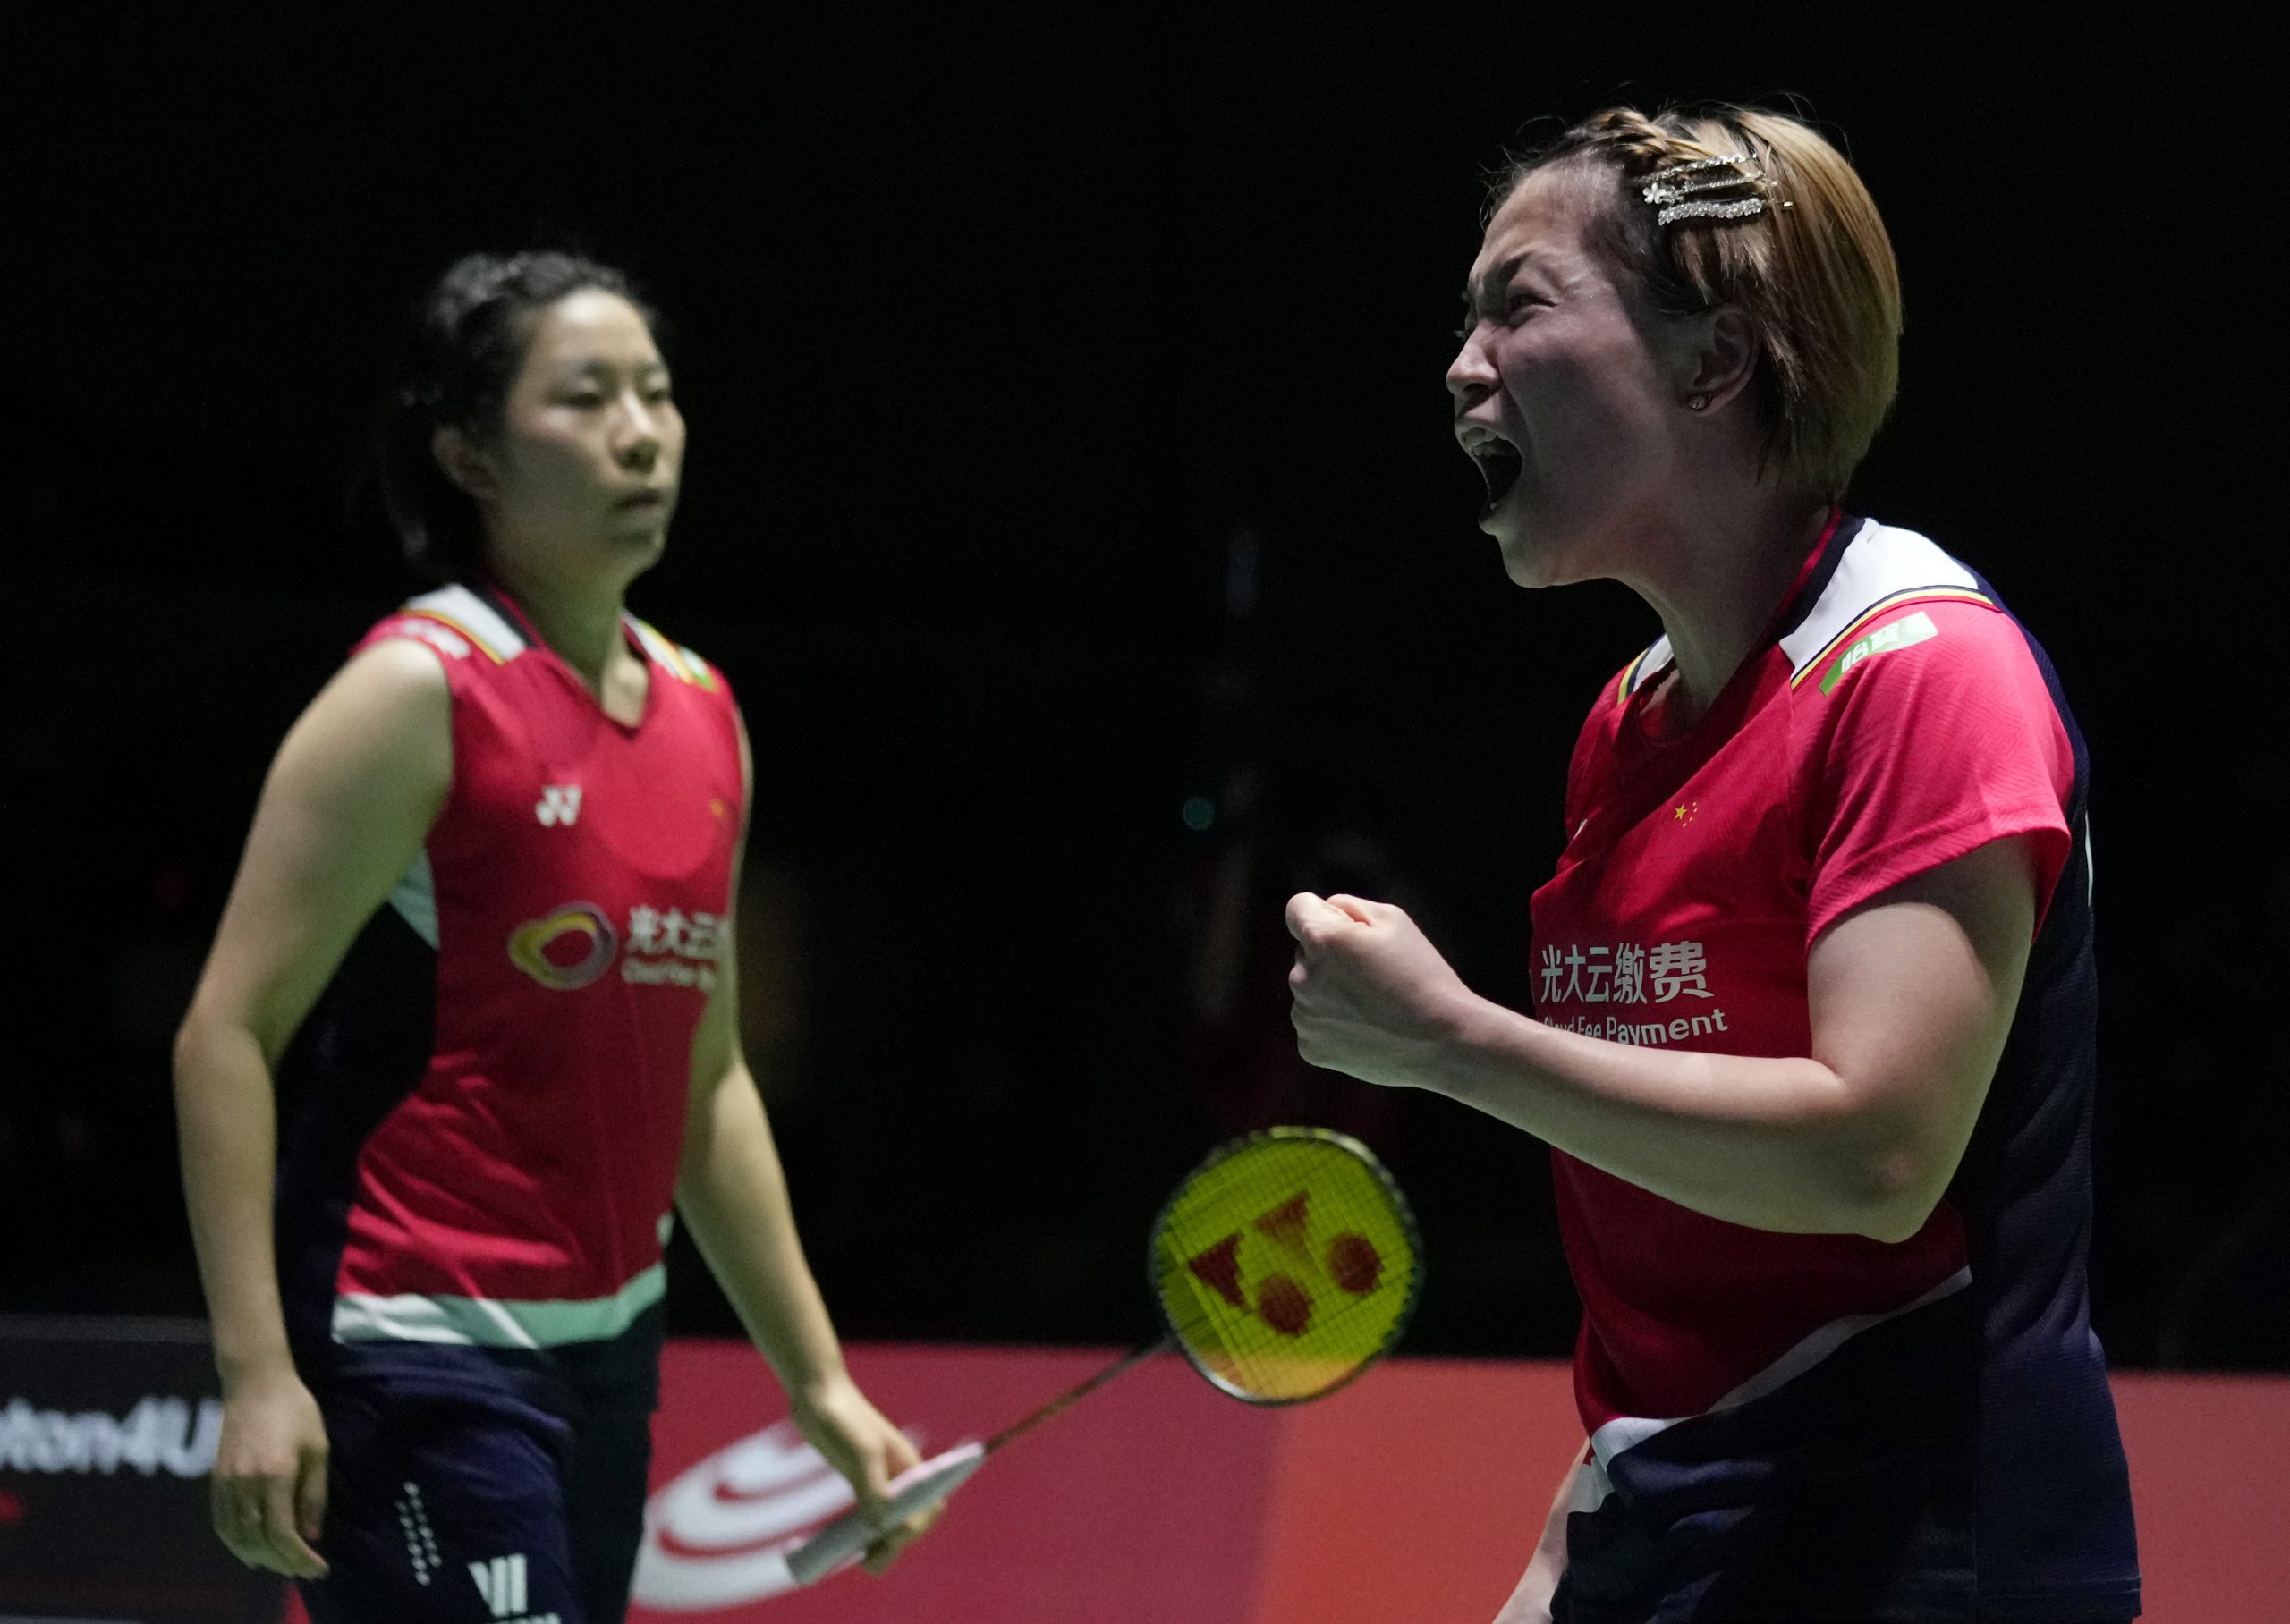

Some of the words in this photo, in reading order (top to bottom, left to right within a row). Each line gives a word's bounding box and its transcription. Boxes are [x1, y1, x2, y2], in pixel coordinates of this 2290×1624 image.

[1540, 940, 1715, 1005] 光大云缴费
[1577, 1016, 1602, 1037] Fee
[1606, 1008, 1728, 1045] Payment
[0, 1396, 223, 1477] ton4U
